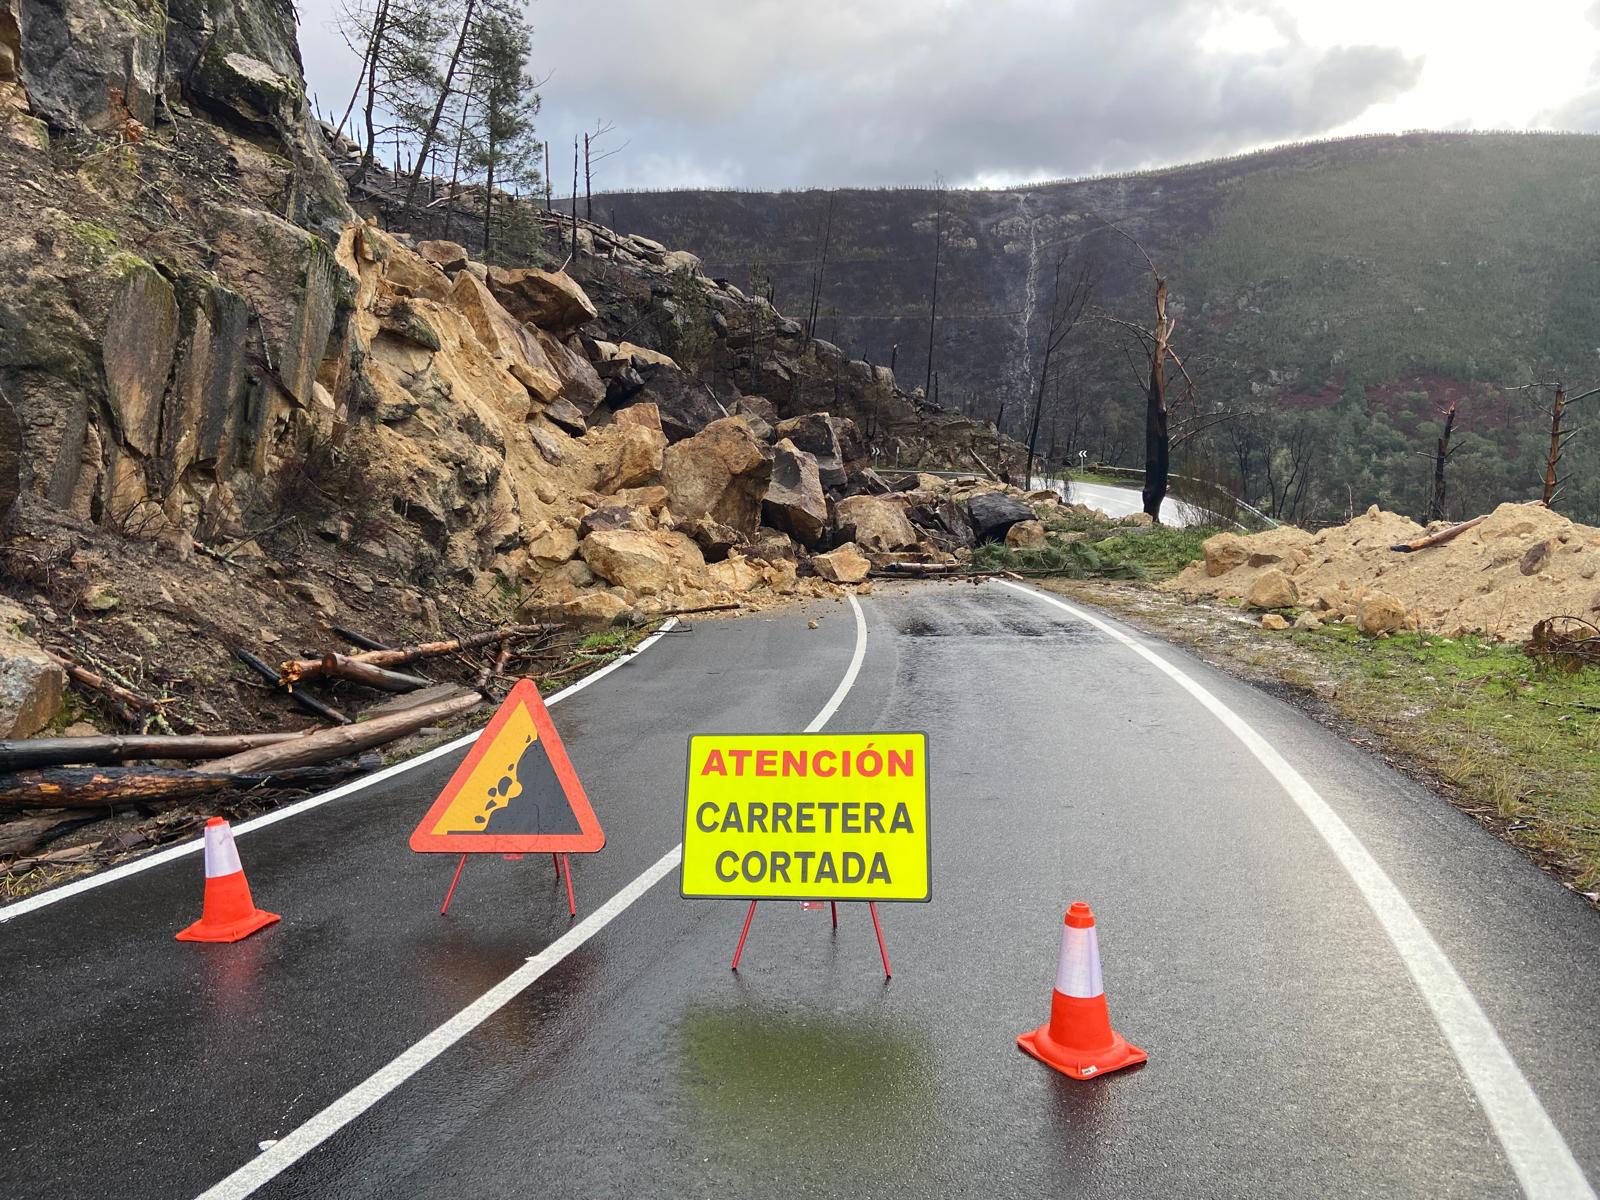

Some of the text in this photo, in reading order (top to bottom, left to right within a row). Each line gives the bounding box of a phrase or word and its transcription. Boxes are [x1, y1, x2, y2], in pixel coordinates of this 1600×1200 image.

[701, 742, 914, 777] ATENCIÓN
[696, 801, 915, 833] CARRETERA
[715, 850, 892, 884] CORTADA
